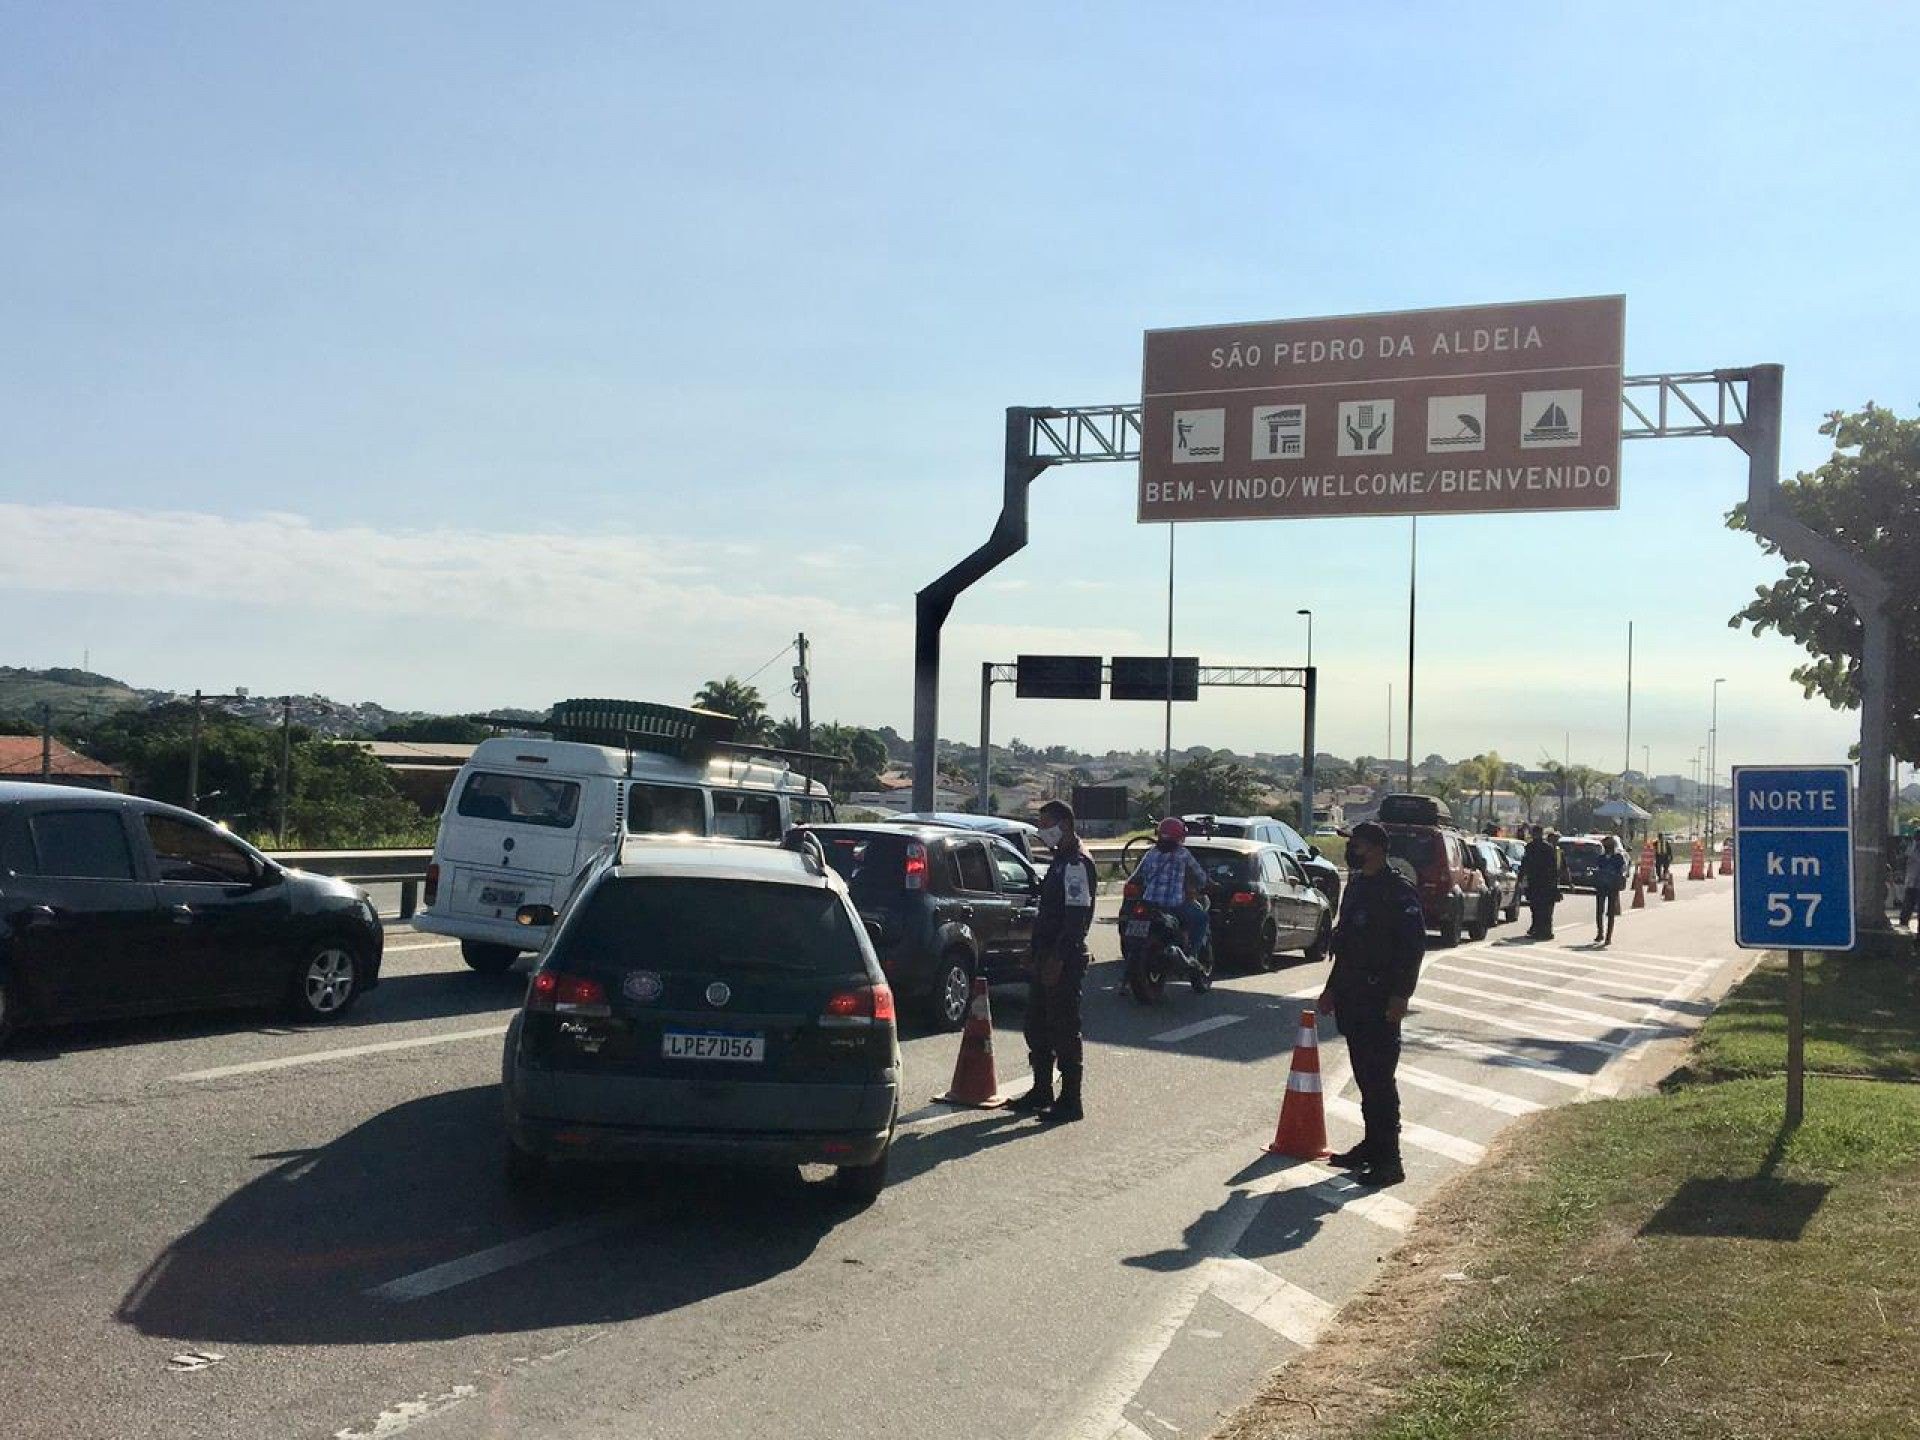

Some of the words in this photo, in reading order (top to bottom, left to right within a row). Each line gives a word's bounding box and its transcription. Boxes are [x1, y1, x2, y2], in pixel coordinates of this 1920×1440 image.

[1211, 341, 1261, 369] SÃO
[1274, 339, 1364, 366] PEDRO
[1379, 333, 1415, 358] DA
[1431, 325, 1543, 355] ALDEIA
[1750, 790, 1837, 810] NORTE
[1767, 851, 1820, 876] km
[1767, 893, 1822, 928] 57
[671, 1036, 754, 1057] LPE7D56
